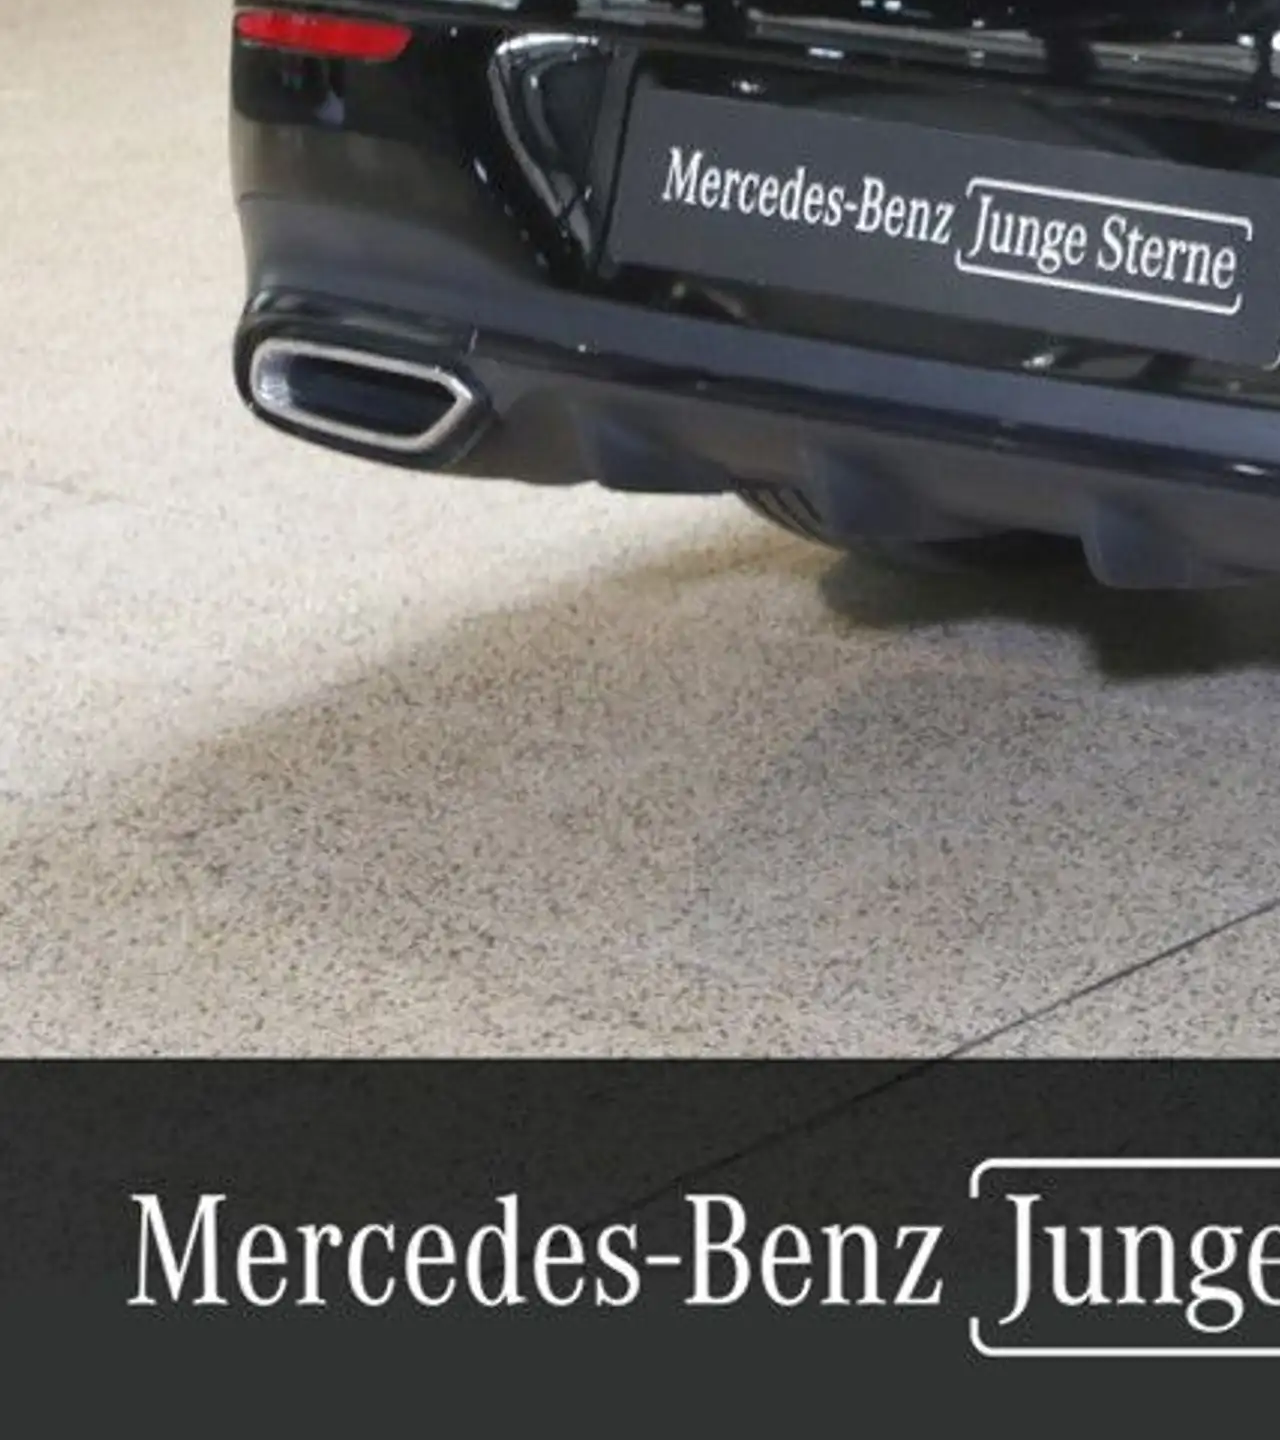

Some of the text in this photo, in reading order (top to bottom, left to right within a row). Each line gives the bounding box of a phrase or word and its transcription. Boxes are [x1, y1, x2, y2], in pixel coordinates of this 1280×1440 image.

[661, 146, 1239, 291] Mercedes-Benz Junge Sterne
